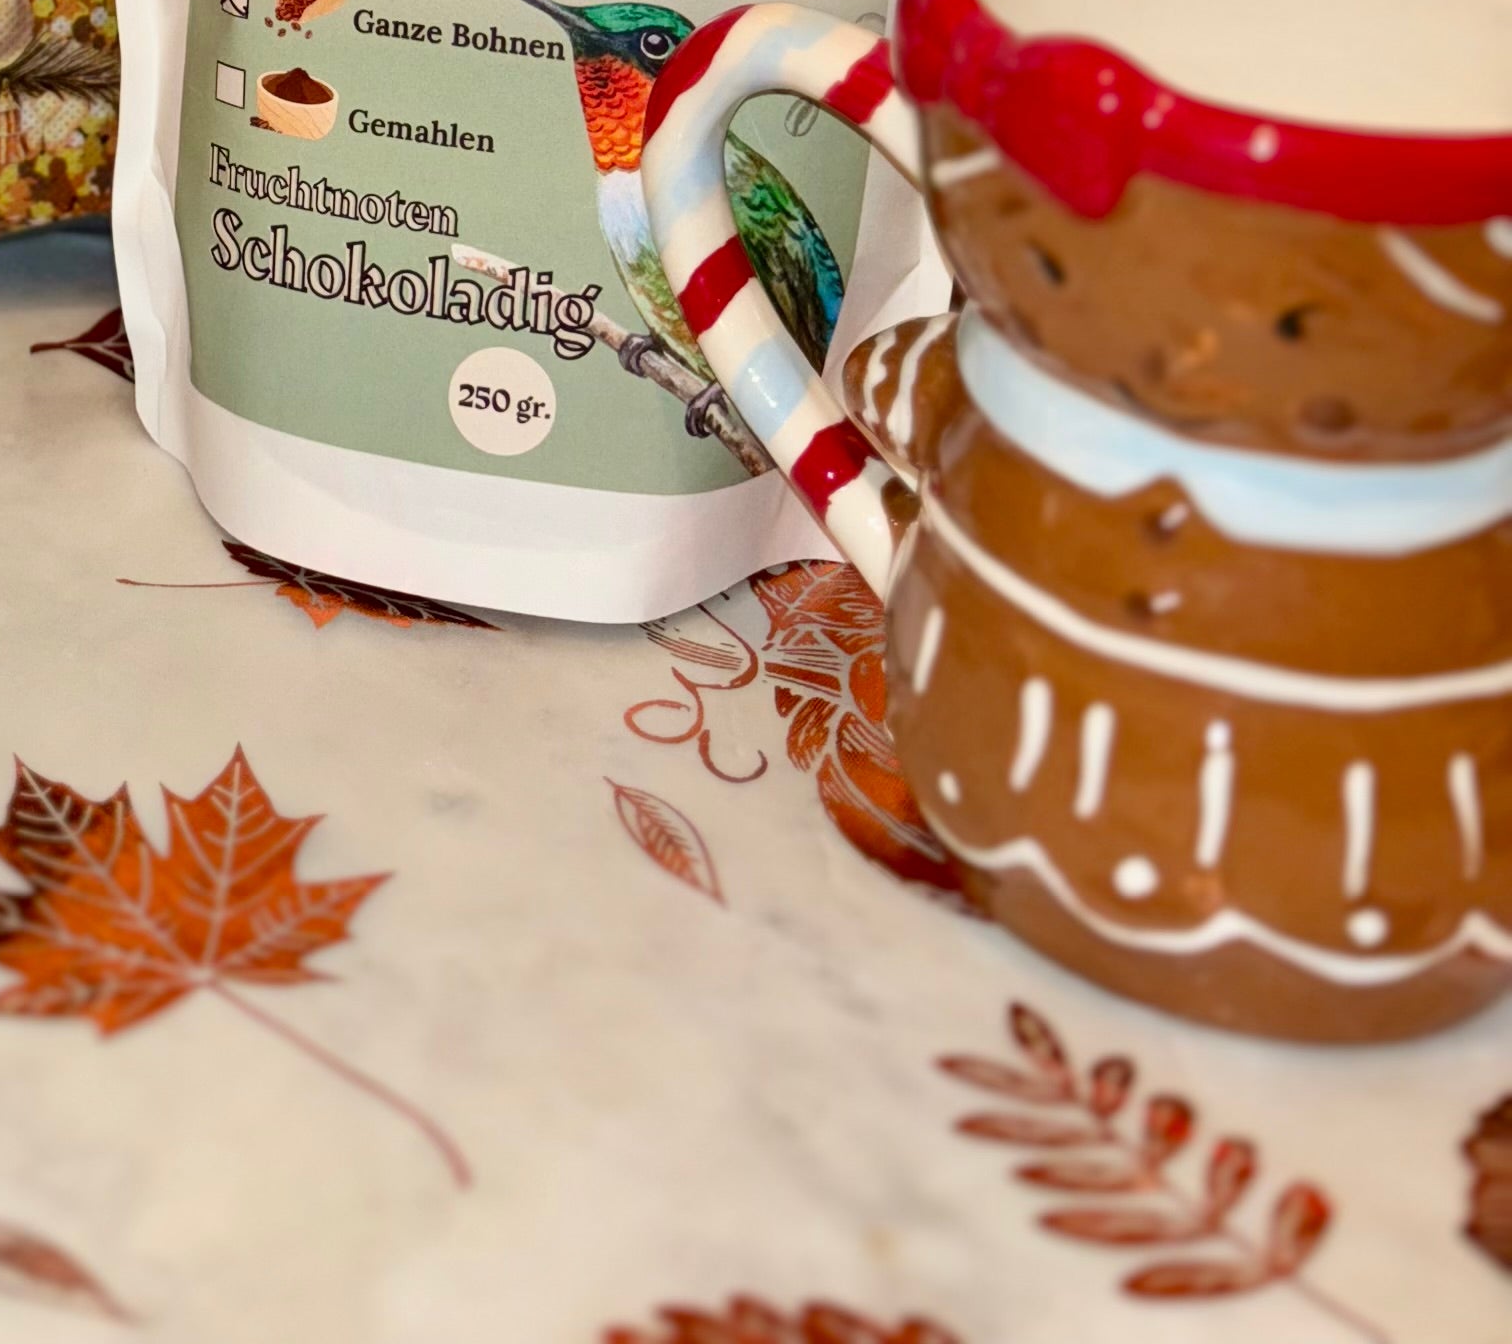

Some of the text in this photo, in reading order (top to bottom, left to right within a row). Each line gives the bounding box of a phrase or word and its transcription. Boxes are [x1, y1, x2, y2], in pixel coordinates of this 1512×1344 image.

[353, 9, 566, 61] Ganze Bohnen
[348, 109, 495, 153] Gemahlen
[209, 143, 459, 237] Fruchtnoten
[210, 208, 604, 360] Schokoladig
[457, 383, 552, 425] 250 gr.
